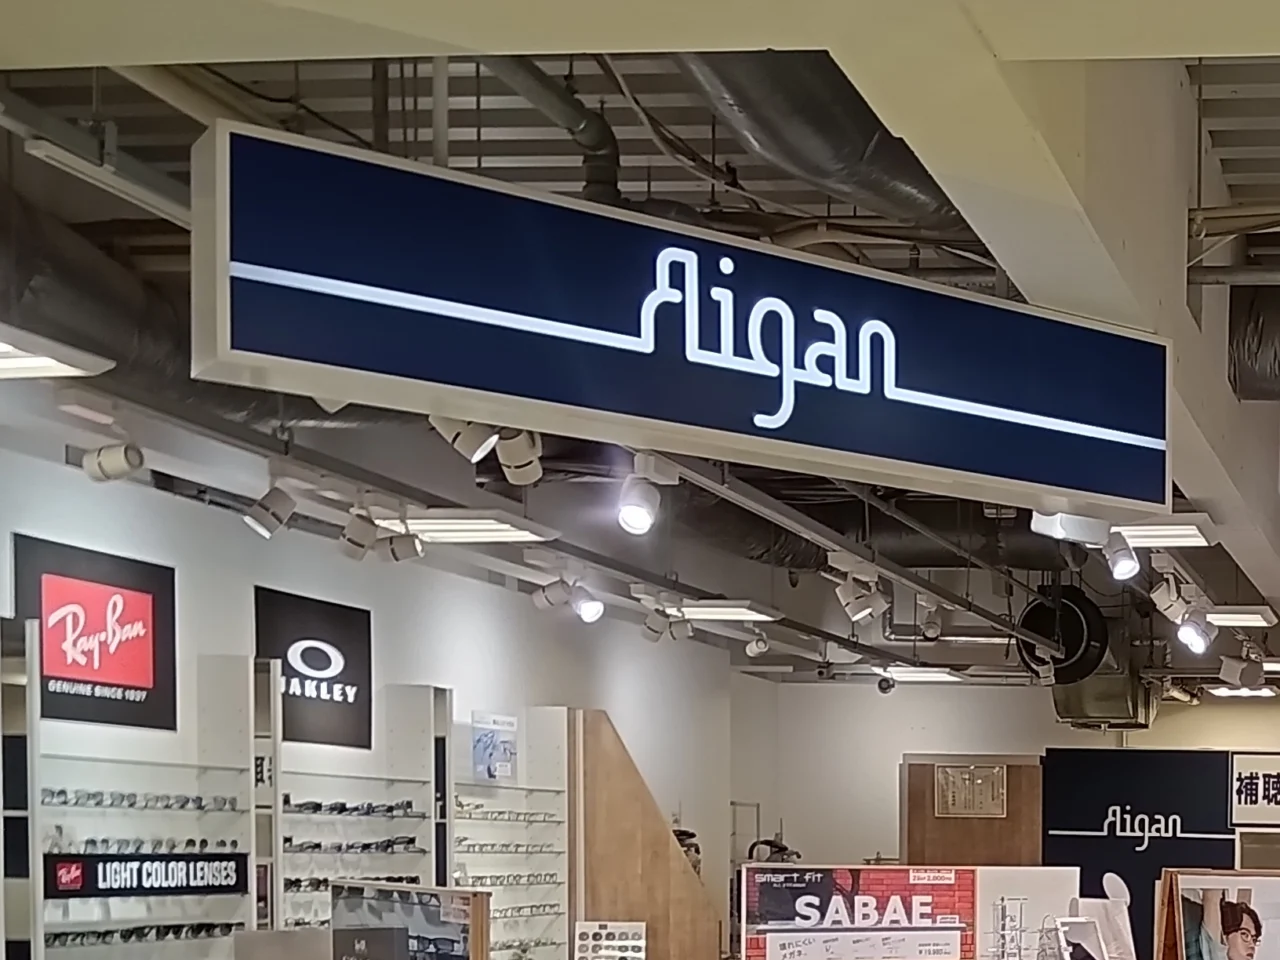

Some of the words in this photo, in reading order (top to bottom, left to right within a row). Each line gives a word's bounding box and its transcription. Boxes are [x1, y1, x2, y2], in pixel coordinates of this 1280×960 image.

[638, 246, 898, 430] Aigan
[48, 680, 93, 697] GENUINE
[94, 685, 124, 700] SINCE
[1103, 805, 1183, 852] Aigan
[97, 861, 141, 890] LIGHT
[142, 861, 187, 889] COLOR
[189, 861, 238, 887] LENSES
[755, 872, 800, 882] smart
[804, 871, 824, 882] fit
[794, 894, 933, 929] SABAE
